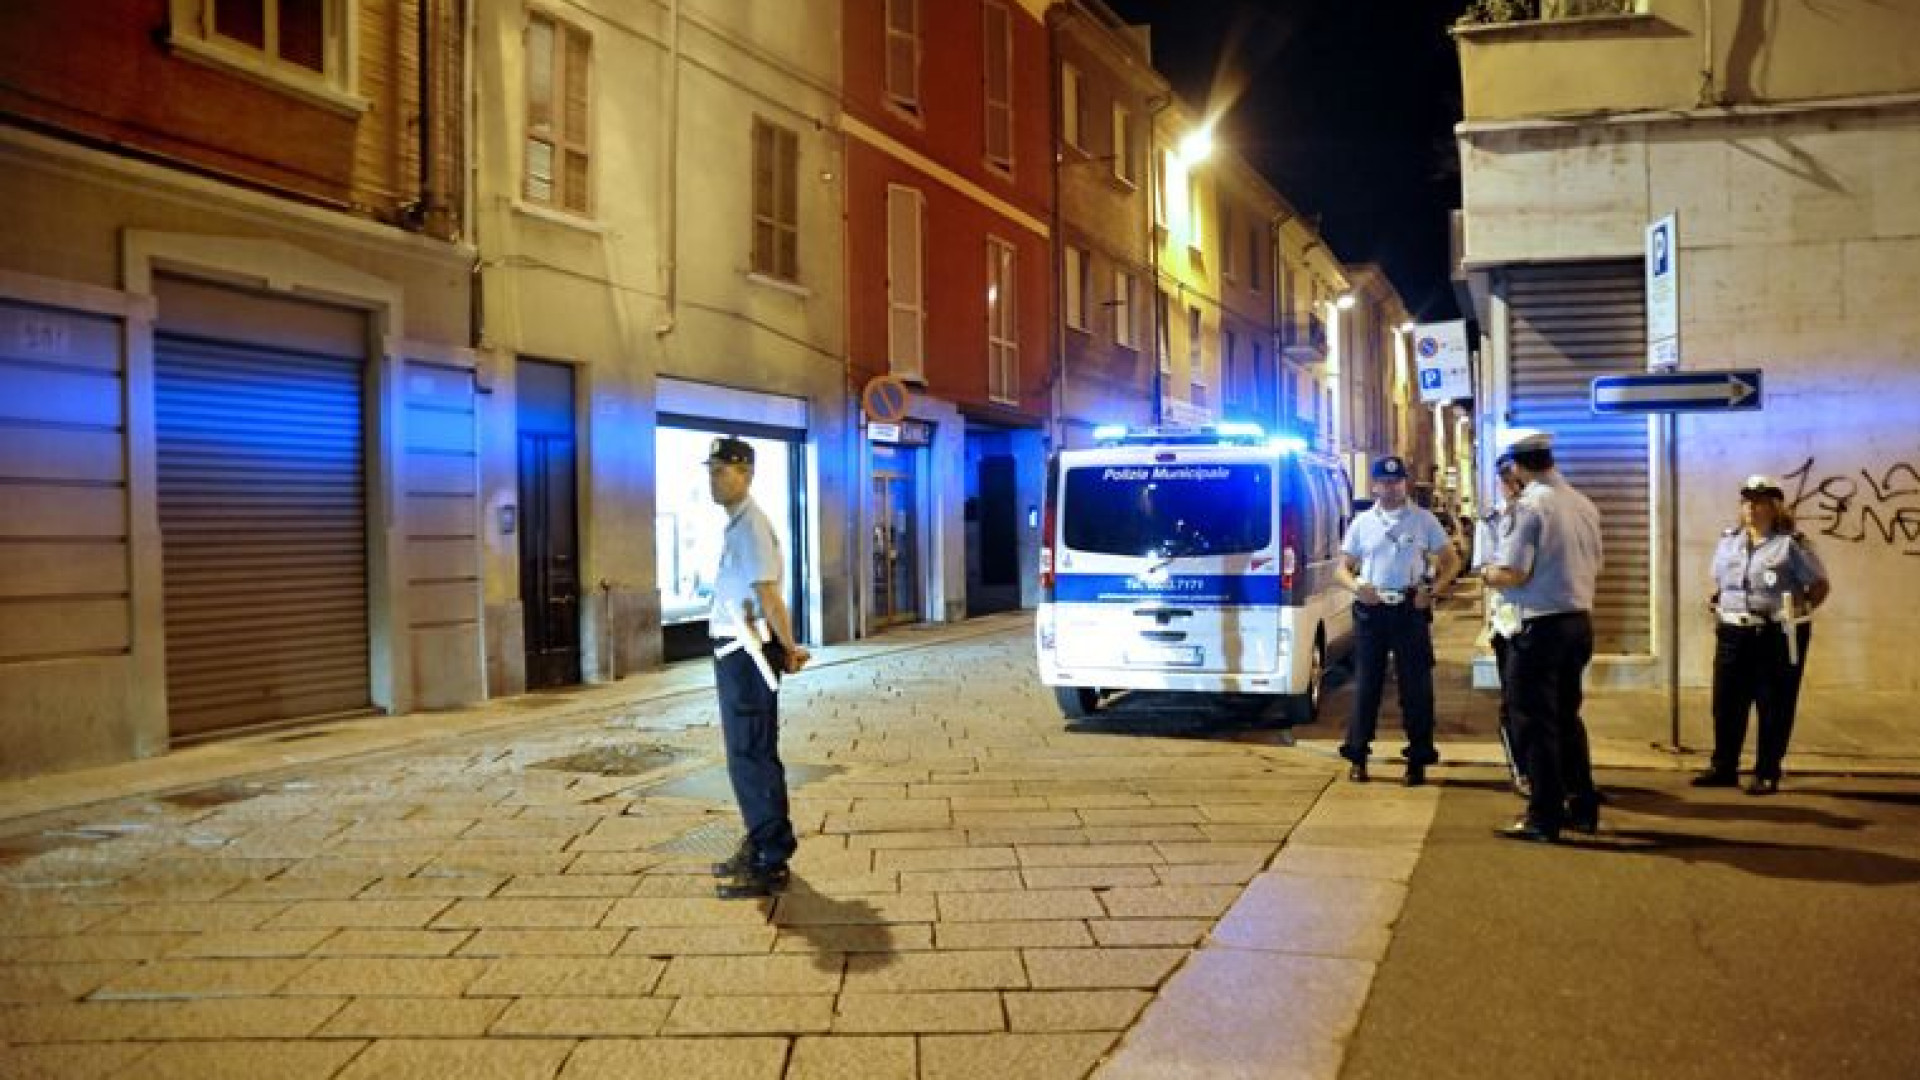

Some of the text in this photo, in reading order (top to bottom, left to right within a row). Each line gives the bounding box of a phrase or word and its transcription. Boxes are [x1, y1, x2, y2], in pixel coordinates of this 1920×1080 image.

[1654, 230, 1666, 273] P
[1424, 370, 1437, 388] P
[1102, 466, 1230, 482] Polizia Municipale
